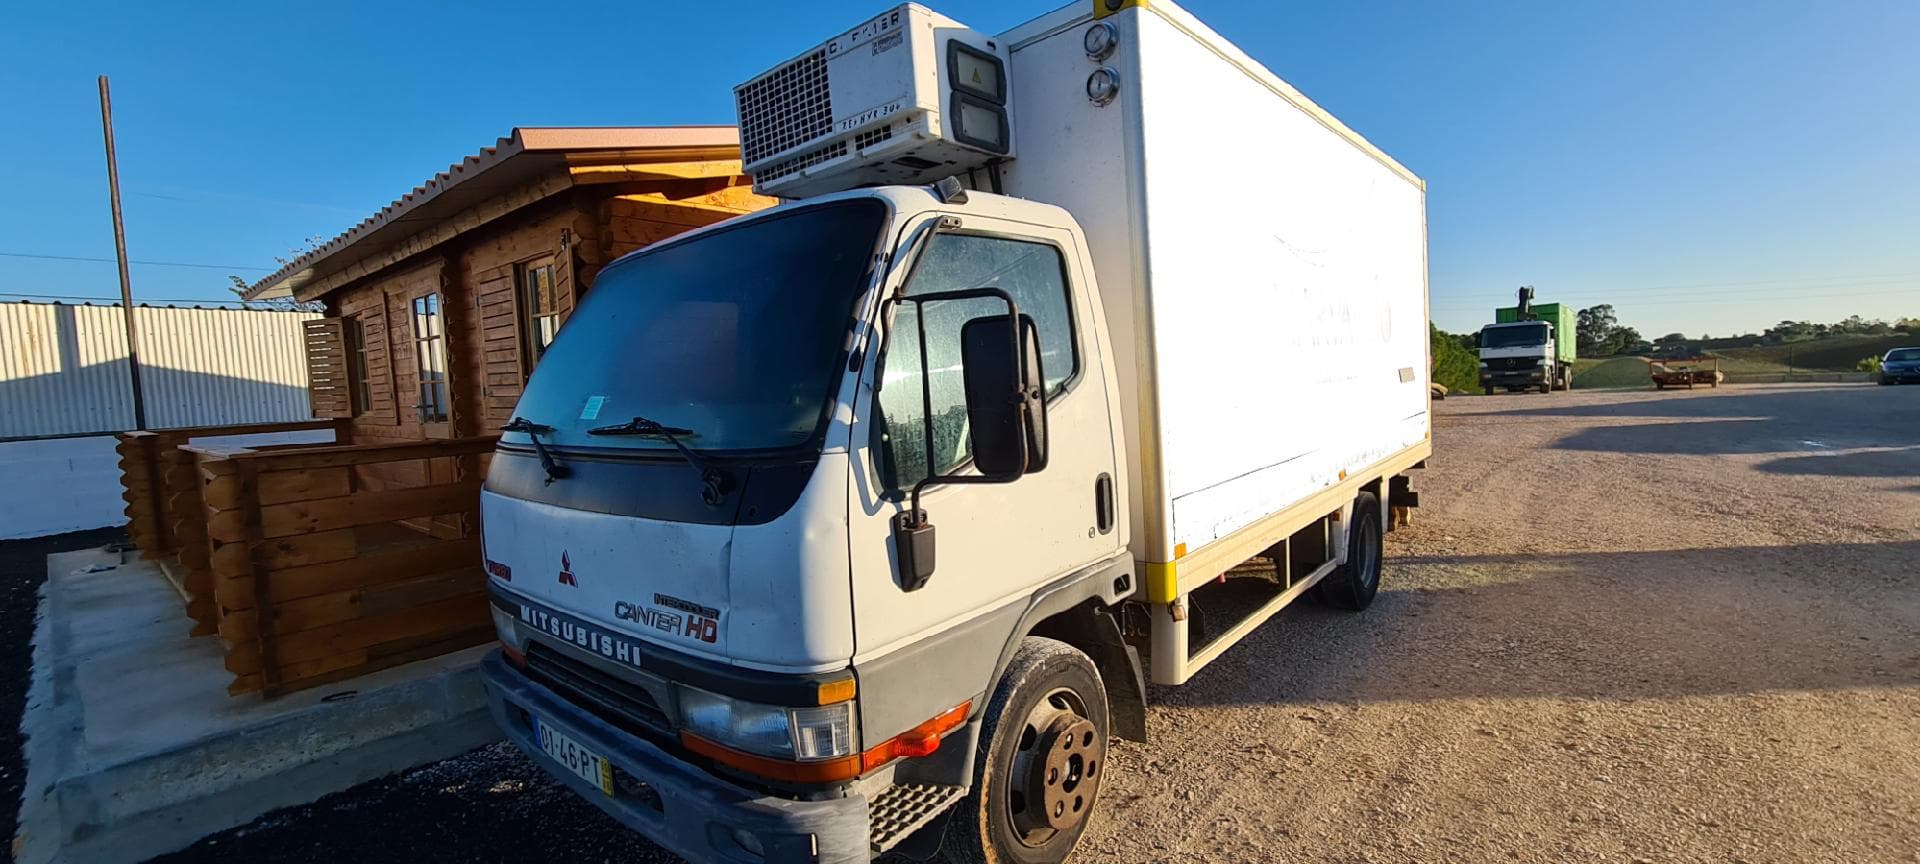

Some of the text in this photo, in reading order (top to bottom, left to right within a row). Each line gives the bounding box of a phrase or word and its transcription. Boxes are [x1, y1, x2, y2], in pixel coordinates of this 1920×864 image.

[520, 604, 641, 666] MITSUBISHI
[614, 600, 718, 644] CANTER HD
